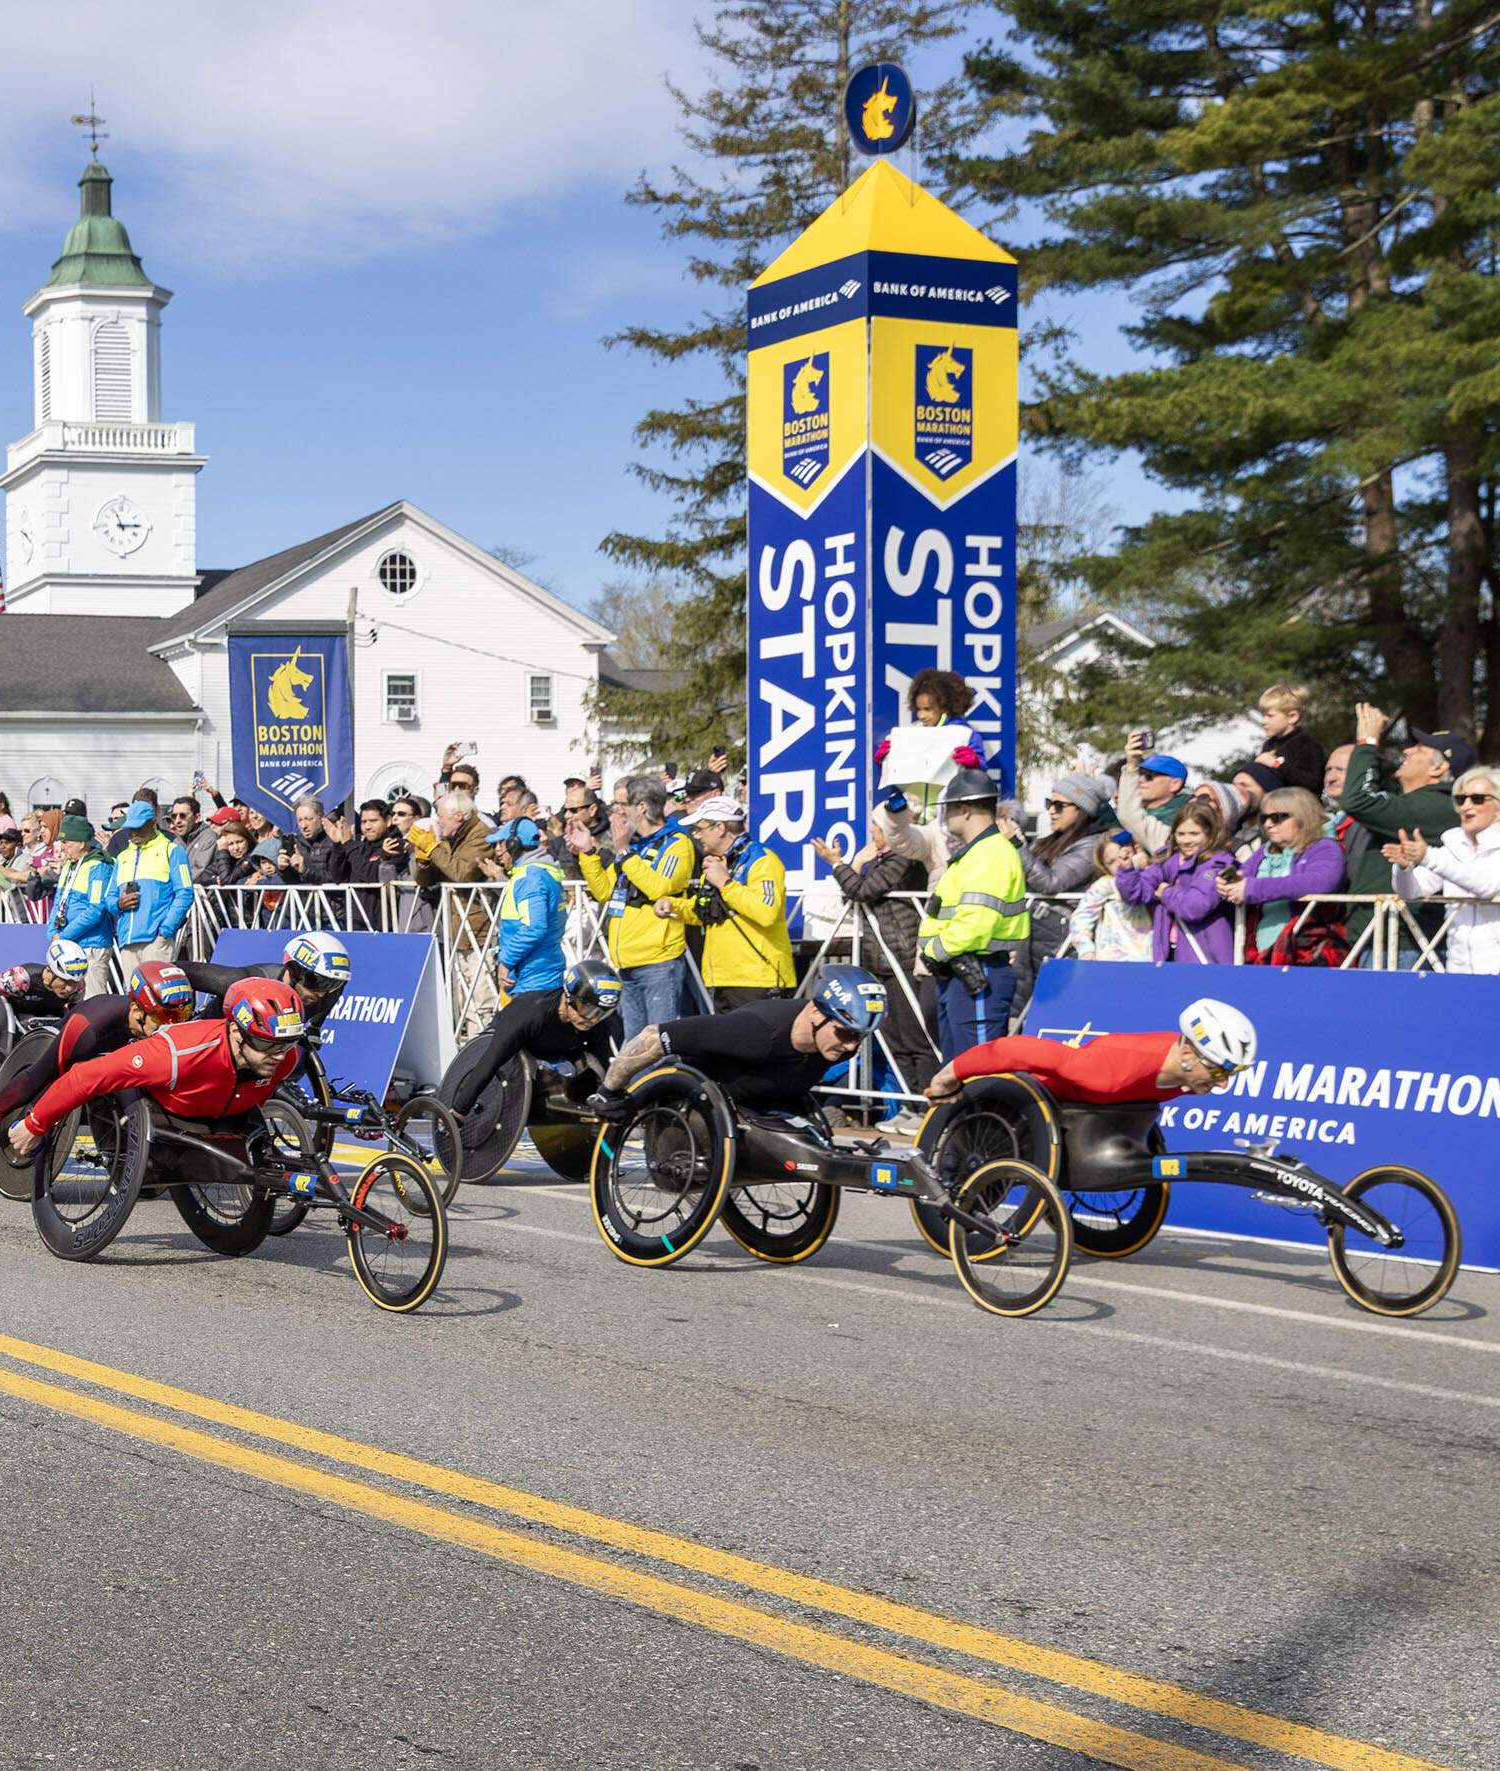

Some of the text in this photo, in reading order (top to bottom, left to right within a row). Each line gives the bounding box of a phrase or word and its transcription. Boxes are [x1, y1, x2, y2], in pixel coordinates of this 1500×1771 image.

[873, 281, 984, 303] BANK OF AMERICA
[751, 291, 839, 329] BANK OF AMERICA
[916, 405, 971, 423] BOSTON
[784, 413, 829, 437] BOSTON
[916, 421, 971, 436] MARATHON
[784, 428, 829, 449] MARATHON
[942, 438, 971, 446] AMERICA
[258, 725, 322, 742] BOSTON
[259, 743, 323, 756] MARATHON
[291, 760, 323, 768] AMERICA
[296, 946, 316, 966] W12
[236, 1006, 253, 1026] W2
[1183, 1108, 1221, 1131] OF
[1222, 1112, 1356, 1145] AMERICA
[295, 1175, 311, 1192] W2
[1276, 1170, 1324, 1200] TOYOTA
